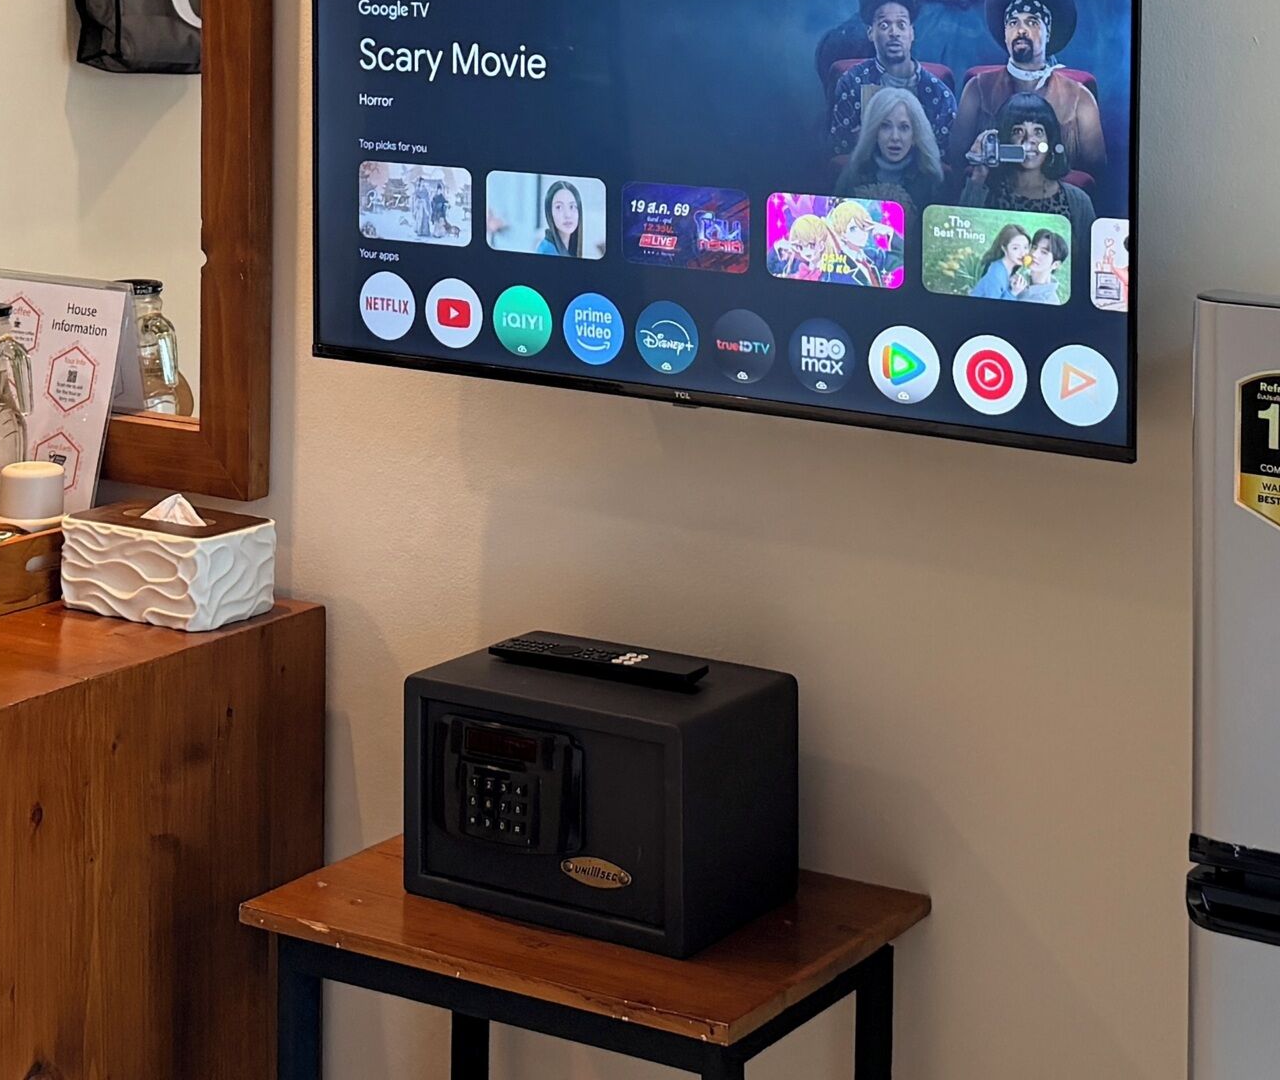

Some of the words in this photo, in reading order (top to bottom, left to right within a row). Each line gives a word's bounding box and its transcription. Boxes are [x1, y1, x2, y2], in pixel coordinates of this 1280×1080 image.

[411, 2, 430, 18] TV
[359, 37, 443, 82] Scary
[452, 42, 547, 79] Movie
[359, 93, 394, 106] Horror
[358, 138, 374, 150] Top
[375, 139, 397, 151] picks
[398, 141, 410, 152] for
[412, 144, 427, 154] you
[631, 199, 646, 213] 19
[647, 201, 671, 215] ส.ค.
[673, 203, 690, 217] 69
[948, 215, 971, 228] The
[651, 235, 673, 247] LIVE
[933, 226, 954, 237] Best
[956, 227, 986, 244] Thing
[359, 247, 377, 259] Your
[379, 251, 400, 262] apps
[66, 302, 98, 317] House
[365, 295, 409, 315] NETFLIX
[502, 311, 543, 331] iQIYI
[574, 307, 612, 324] prime
[51, 319, 108, 337] Information
[576, 323, 612, 339] video
[801, 336, 847, 360] HBO
[801, 358, 844, 376] max
[674, 390, 692, 400] TCL
[1257, 494, 1280, 505] BEST
